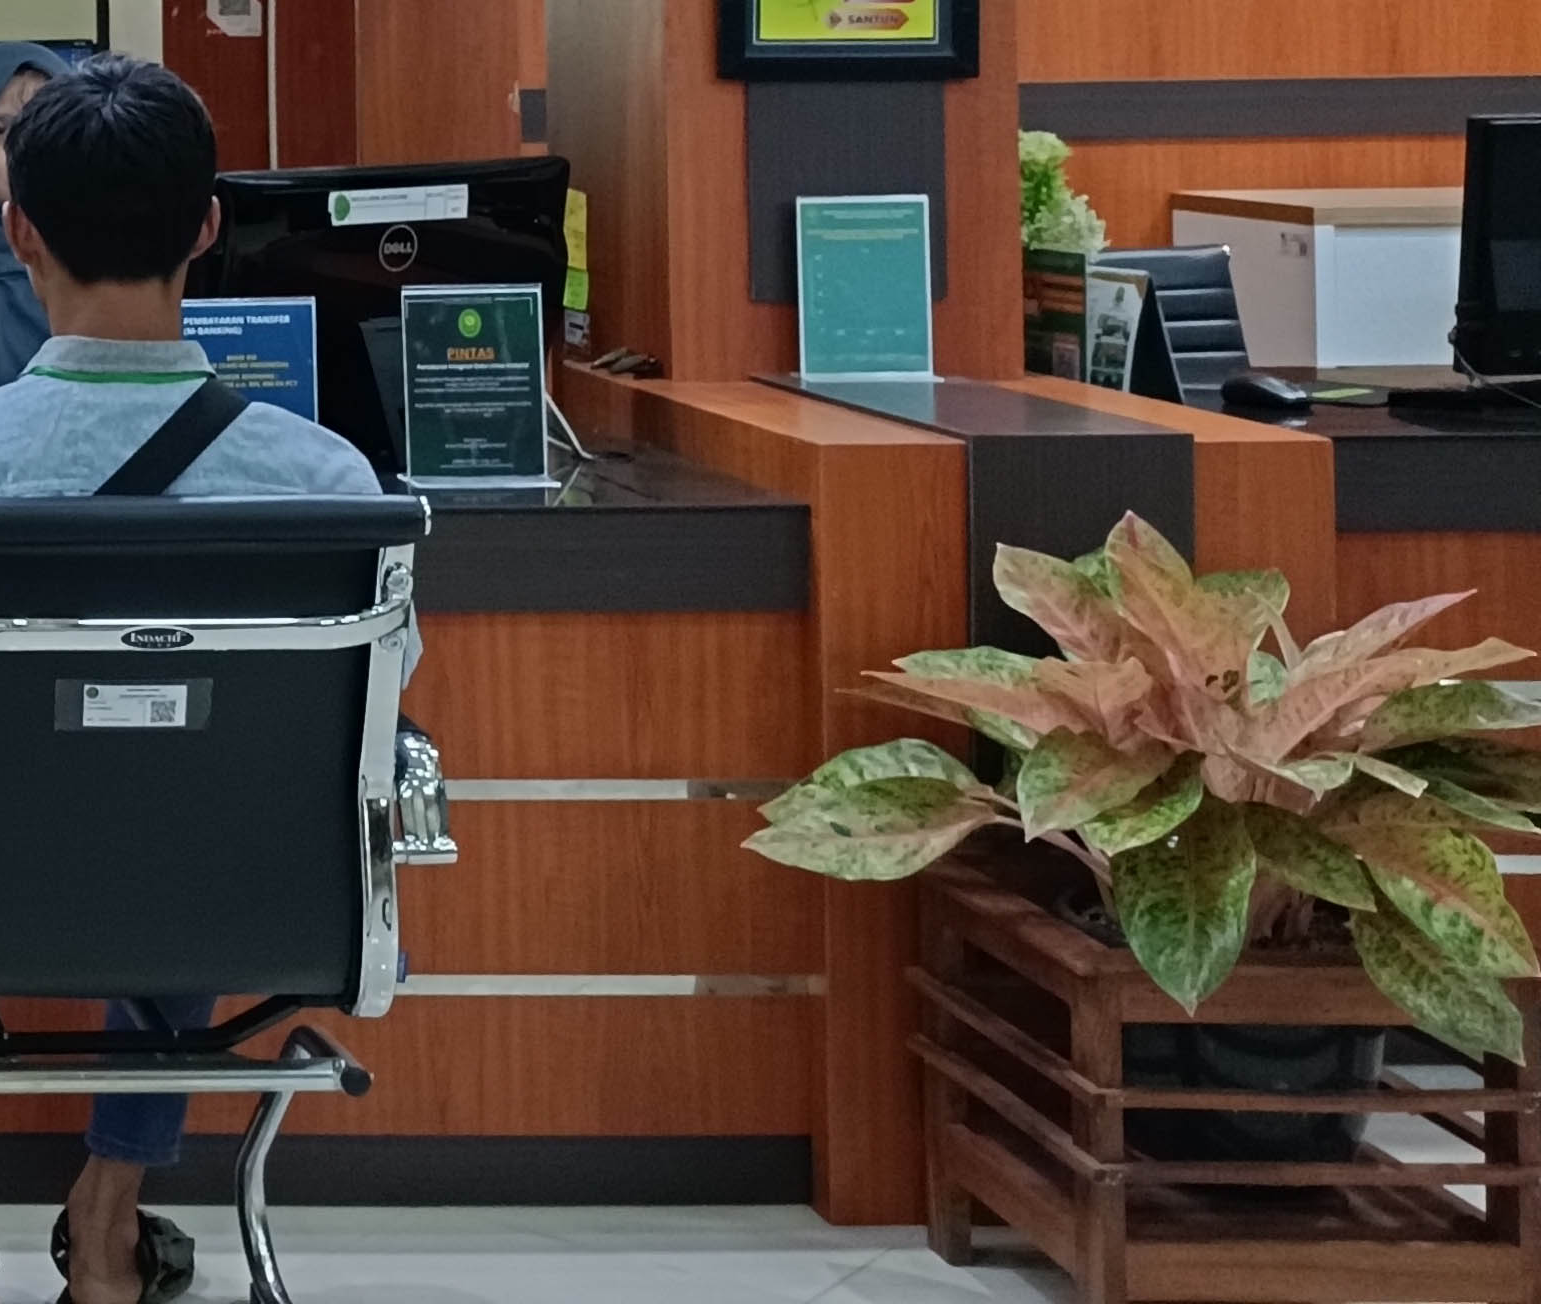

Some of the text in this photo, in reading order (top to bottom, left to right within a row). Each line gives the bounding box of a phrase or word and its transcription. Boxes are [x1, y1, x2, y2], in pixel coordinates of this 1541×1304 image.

[848, 14, 899, 24] SANTUN
[384, 242, 413, 254] DELL
[447, 347, 495, 360] PINTAS
